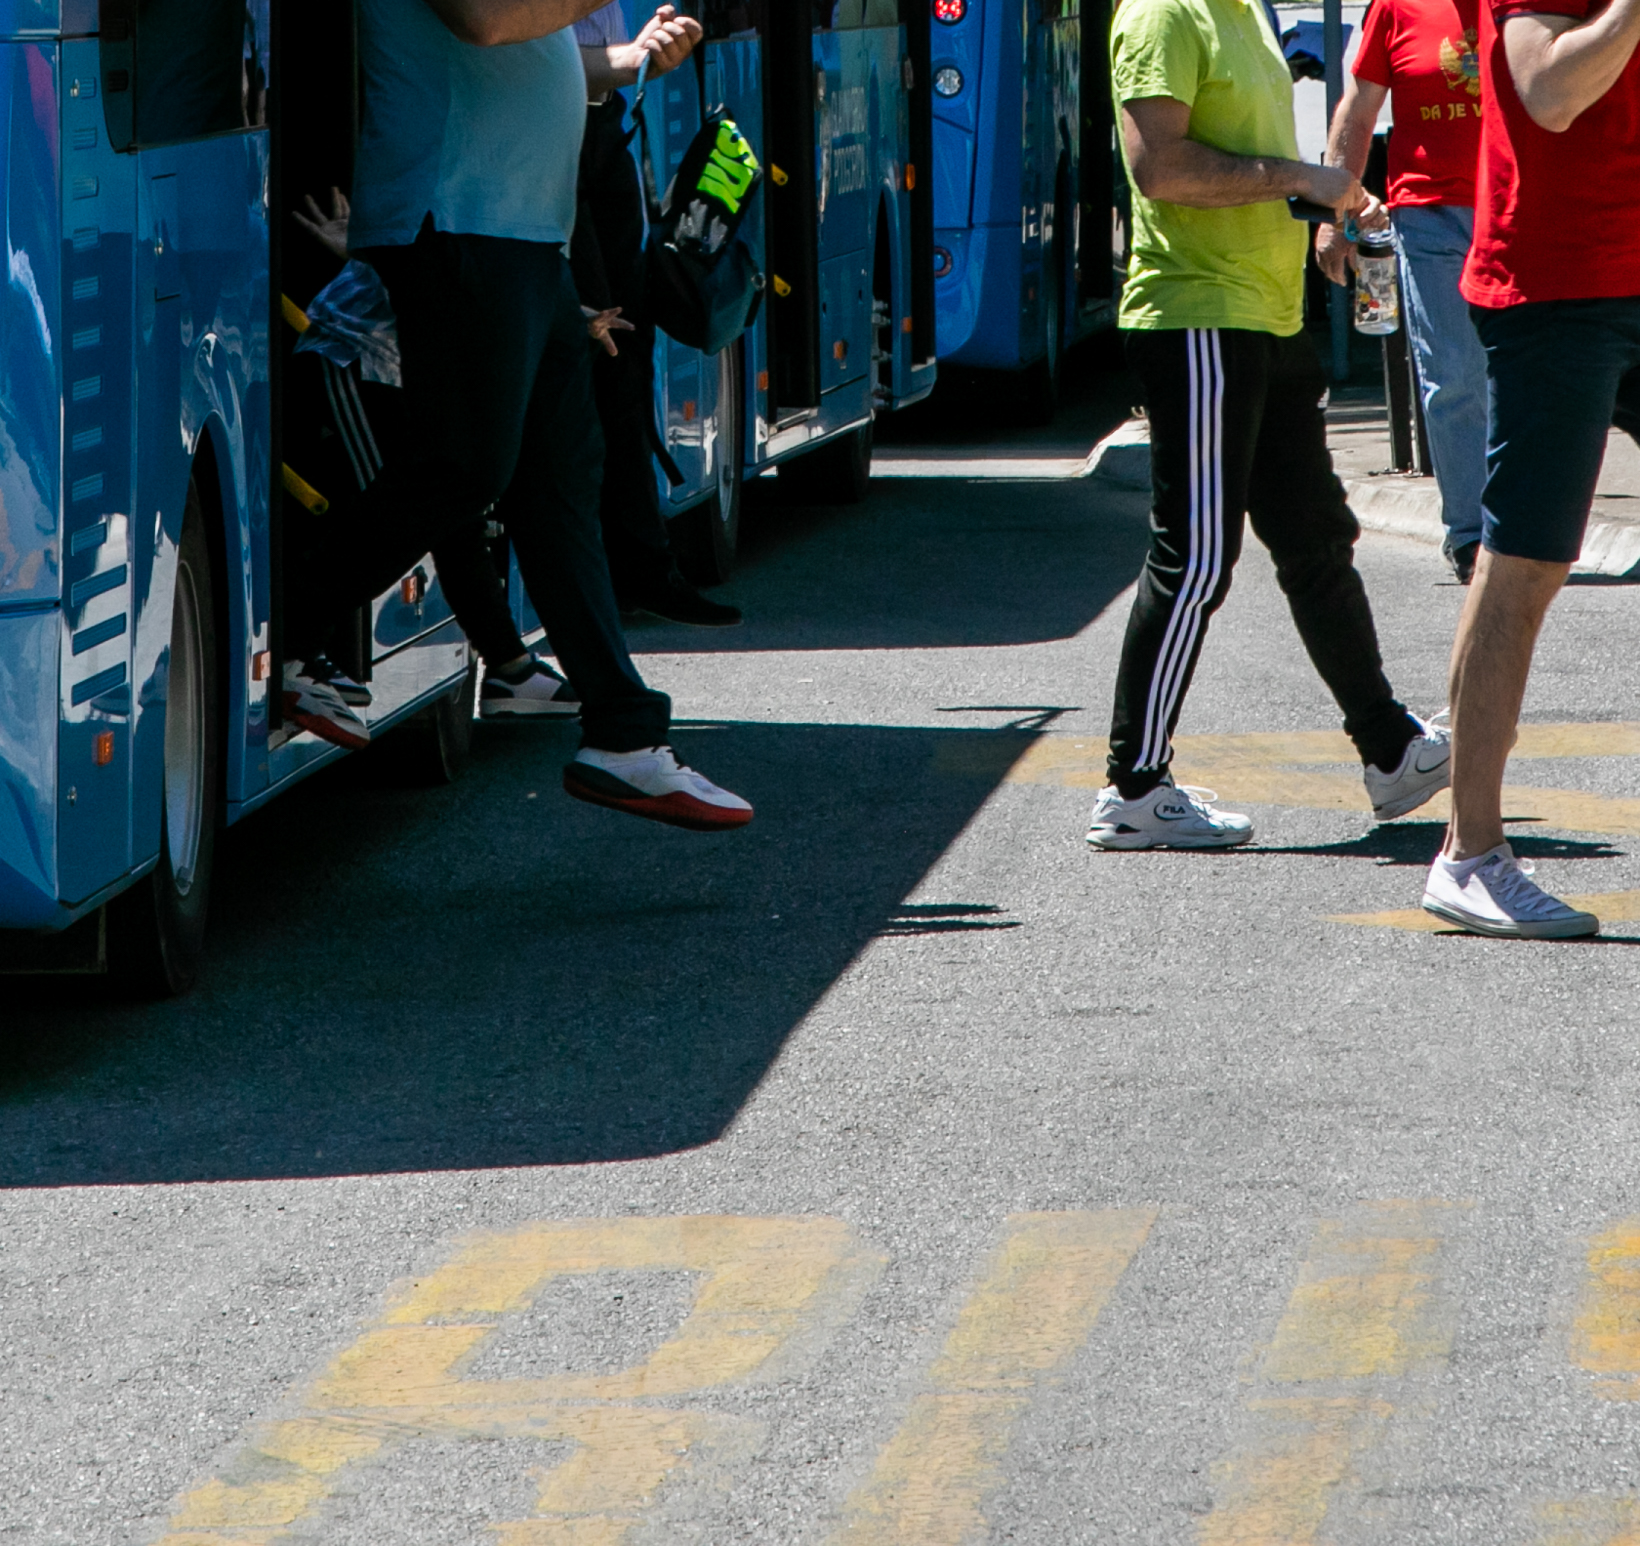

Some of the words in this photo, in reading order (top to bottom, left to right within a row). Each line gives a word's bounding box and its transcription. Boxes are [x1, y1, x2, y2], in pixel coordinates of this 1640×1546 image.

[1419, 103, 1442, 122] DA
[1446, 101, 1468, 122] JE
[1162, 804, 1186, 815] FILA
